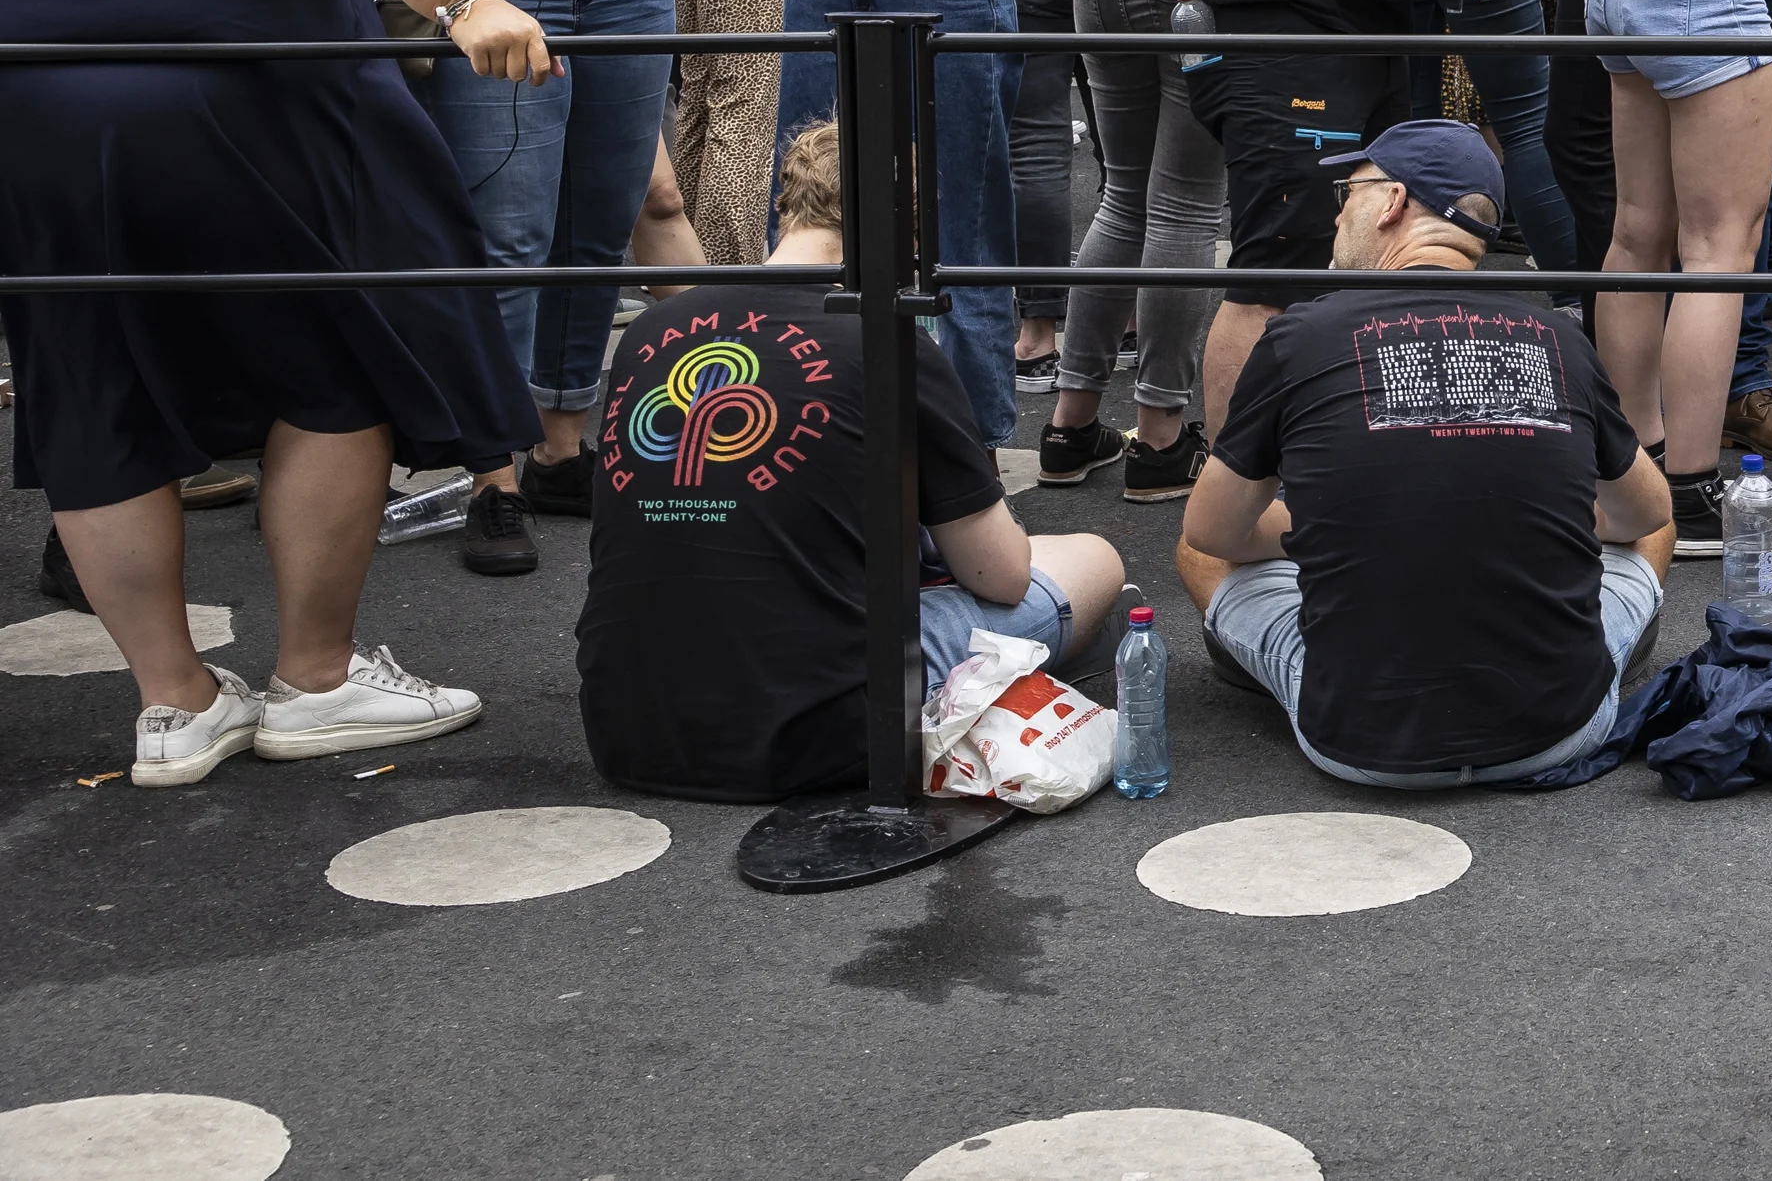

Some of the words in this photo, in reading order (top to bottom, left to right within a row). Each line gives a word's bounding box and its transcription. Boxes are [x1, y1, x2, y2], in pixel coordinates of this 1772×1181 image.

[737, 311, 768, 333] X
[638, 311, 719, 363] JAM
[776, 324, 833, 384] TEN
[603, 375, 635, 492] PEARL
[1430, 429, 1461, 437] TWENTY
[1465, 427, 1515, 436] TWENTY-TWO
[1517, 428, 1535, 437] TOUR
[747, 401, 831, 492] CLUB
[638, 500, 664, 509] TWO
[668, 499, 737, 509] THOUSAND
[644, 512, 727, 522] TWENTY-ONE
[1044, 735, 1061, 750] shop
[1056, 725, 1072, 740] 24/7
